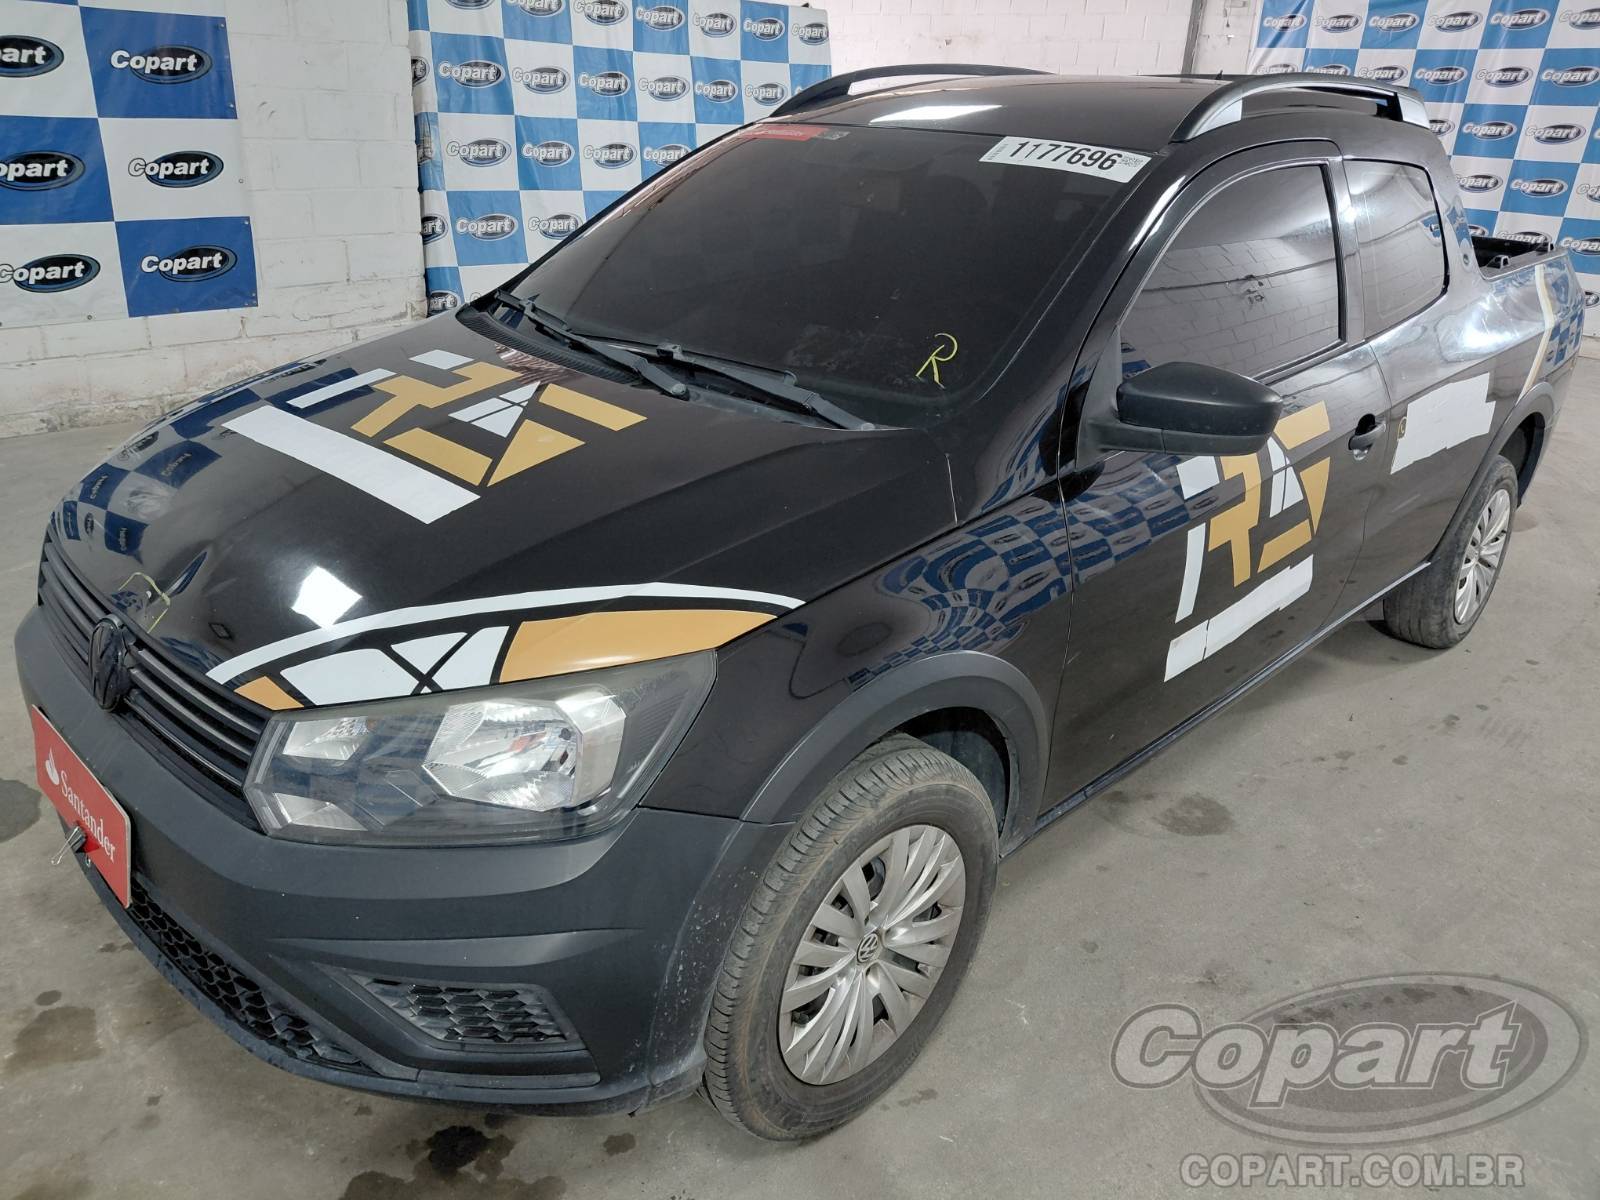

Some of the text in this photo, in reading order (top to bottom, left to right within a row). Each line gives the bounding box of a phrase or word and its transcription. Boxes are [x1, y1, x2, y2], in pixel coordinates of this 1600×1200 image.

[574, 2, 623, 19] Copart
[636, 6, 679, 25] Copart
[1490, 10, 1542, 28] Copart
[693, 12, 733, 31] Copart
[743, 18, 780, 36] Copart
[1263, 16, 1300, 31] Copart
[1314, 15, 1356, 31] Copart
[1369, 14, 1413, 30] Copart
[1429, 12, 1475, 30] Copart
[791, 23, 827, 40] Copart
[0, 46, 47, 65] art
[110, 49, 198, 74] Copart
[439, 61, 496, 83] Copart
[512, 67, 563, 86] Copart
[1359, 66, 1402, 82] Copart
[1415, 67, 1462, 83] Copart
[1476, 68, 1527, 84] Copart
[1541, 69, 1594, 86] Copart
[579, 73, 626, 91] Copart
[638, 77, 683, 95] Copart
[695, 81, 733, 98] Copart
[745, 85, 782, 102] Copart
[1463, 121, 1511, 137] Copart
[1525, 124, 1578, 141] Copart
[447, 140, 503, 160] Copart
[522, 143, 570, 161] Copart
[583, 145, 630, 163] Copart
[1009, 141, 1123, 171] 1177696
[128, 156, 210, 179] Copart
[1510, 178, 1561, 195] Copart
[456, 217, 511, 234] Copart
[528, 216, 576, 233] Copart
[0, 260, 85, 284] Copart
[141, 251, 223, 275] Copart
[915, 332, 958, 389] R
[60, 770, 116, 863] Santander
